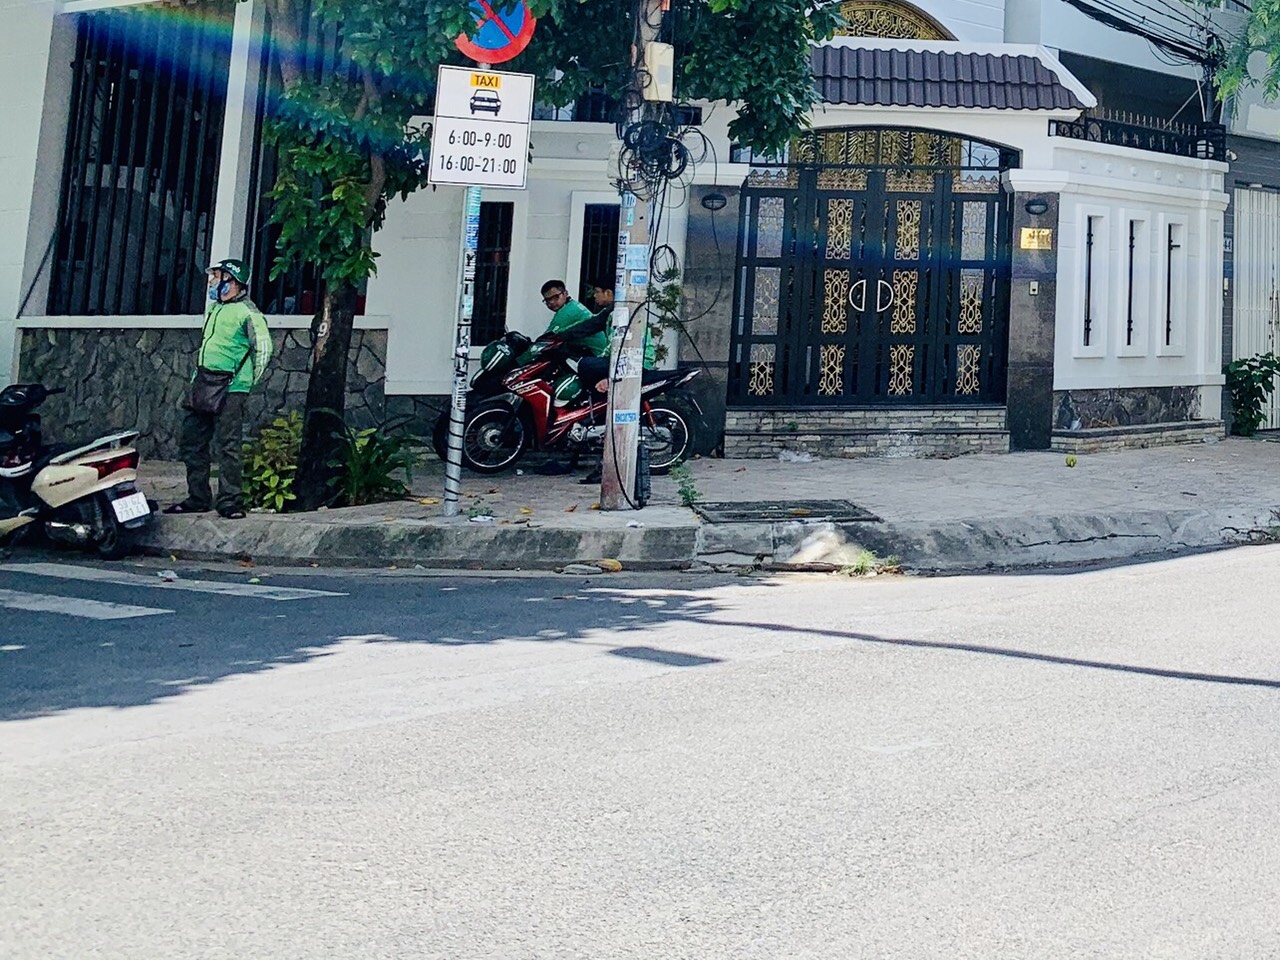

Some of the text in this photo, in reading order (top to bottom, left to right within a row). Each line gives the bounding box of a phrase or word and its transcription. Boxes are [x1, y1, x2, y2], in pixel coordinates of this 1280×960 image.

[475, 75, 499, 87] TAXI
[448, 129, 512, 149] 6:00-9:00
[439, 154, 517, 175] 16:00-21:00
[226, 262, 241, 273] Grab
